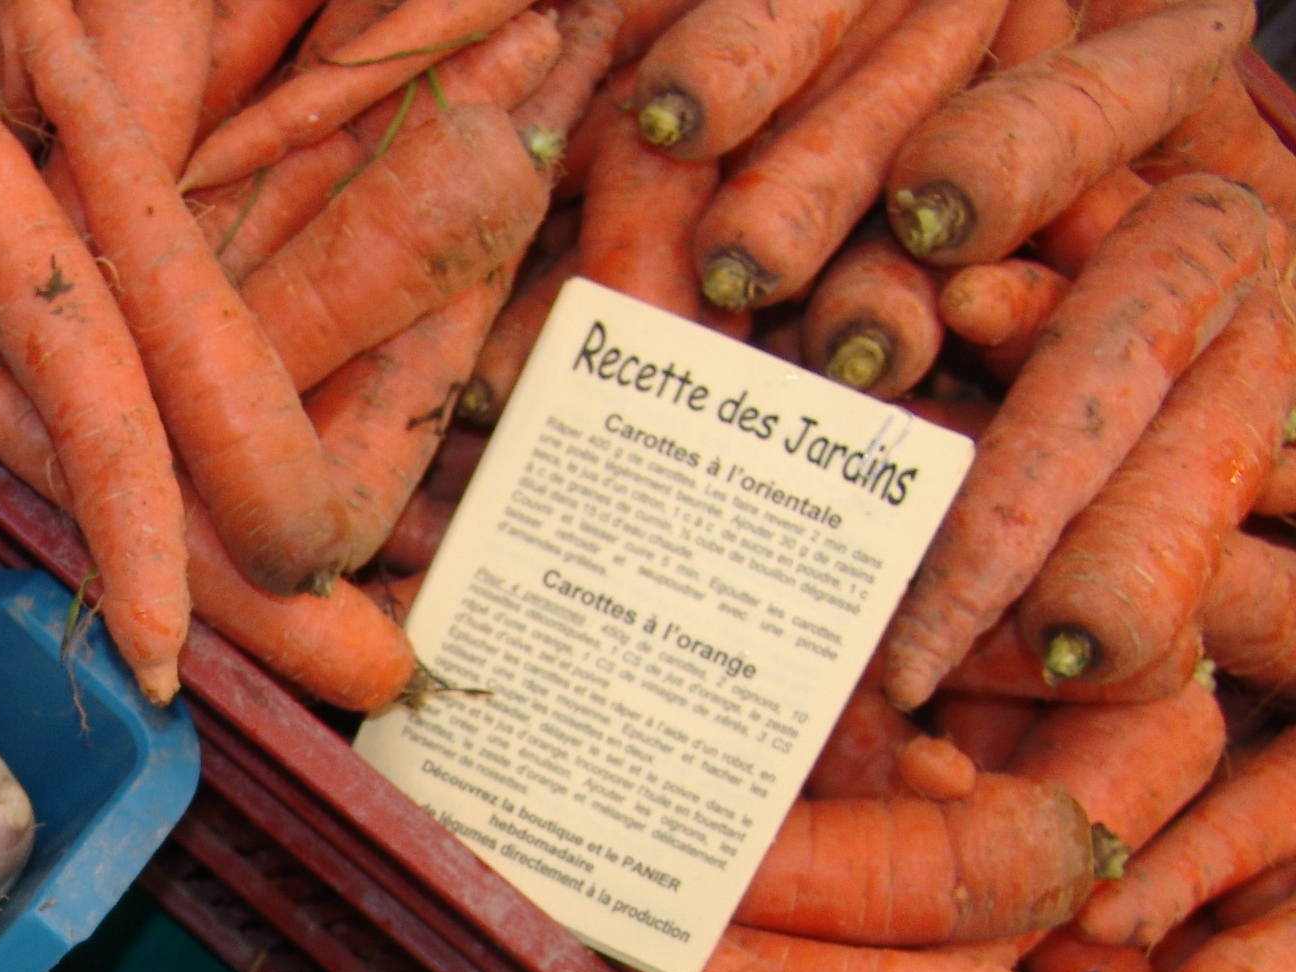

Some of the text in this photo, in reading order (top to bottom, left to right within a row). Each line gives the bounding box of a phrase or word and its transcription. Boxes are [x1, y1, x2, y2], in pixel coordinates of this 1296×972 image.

[572, 320, 919, 507] Recette des Jardins
[605, 413, 842, 529] Carottes à l'orientale
[542, 569, 757, 679] Carottes à l'orange
[421, 759, 681, 892] Découvrez la boutique et le PANIER
[489, 813, 595, 873] hebdomadaire
[500, 843, 584, 893] directement
[586, 882, 596, 898] à
[598, 888, 612, 905] la
[611, 900, 691, 943] production
